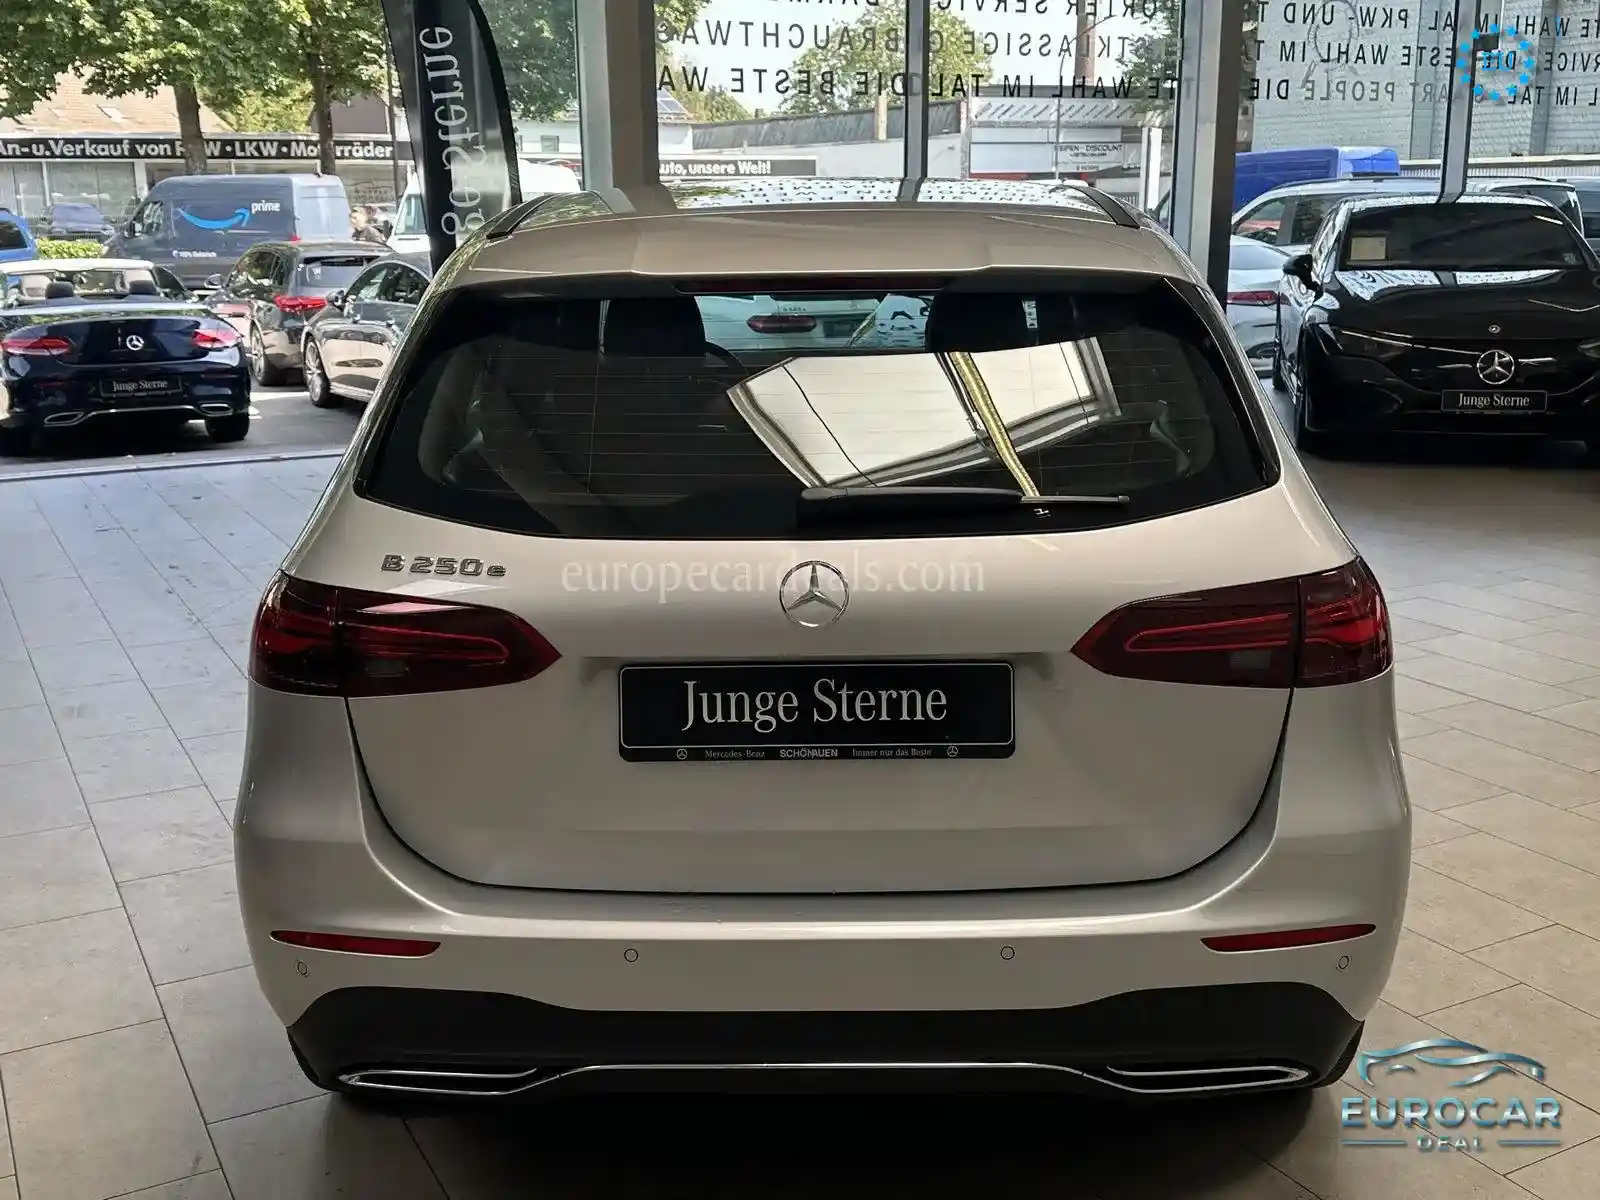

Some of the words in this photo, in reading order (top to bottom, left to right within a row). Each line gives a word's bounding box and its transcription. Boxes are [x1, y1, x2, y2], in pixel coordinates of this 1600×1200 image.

[135, 143, 172, 156] von
[174, 140, 222, 157] PW
[234, 140, 279, 157] LKW
[290, 140, 393, 158] Morräder
[659, 161, 687, 176] uto,
[688, 163, 736, 175] unsere
[737, 160, 771, 175] Welt!
[251, 199, 281, 214] prime
[112, 380, 138, 392] Junge
[139, 380, 168, 390] Sterne
[1458, 393, 1491, 408] Junge
[1493, 393, 1530, 407] Sterne
[381, 554, 406, 572] B
[681, 680, 799, 733] Junge
[813, 678, 947, 723] Sterne
[705, 749, 766, 759] Mercedes-Benz
[852, 748, 878, 757] Immer
[880, 749, 893, 757] nur
[896, 747, 909, 757] das
